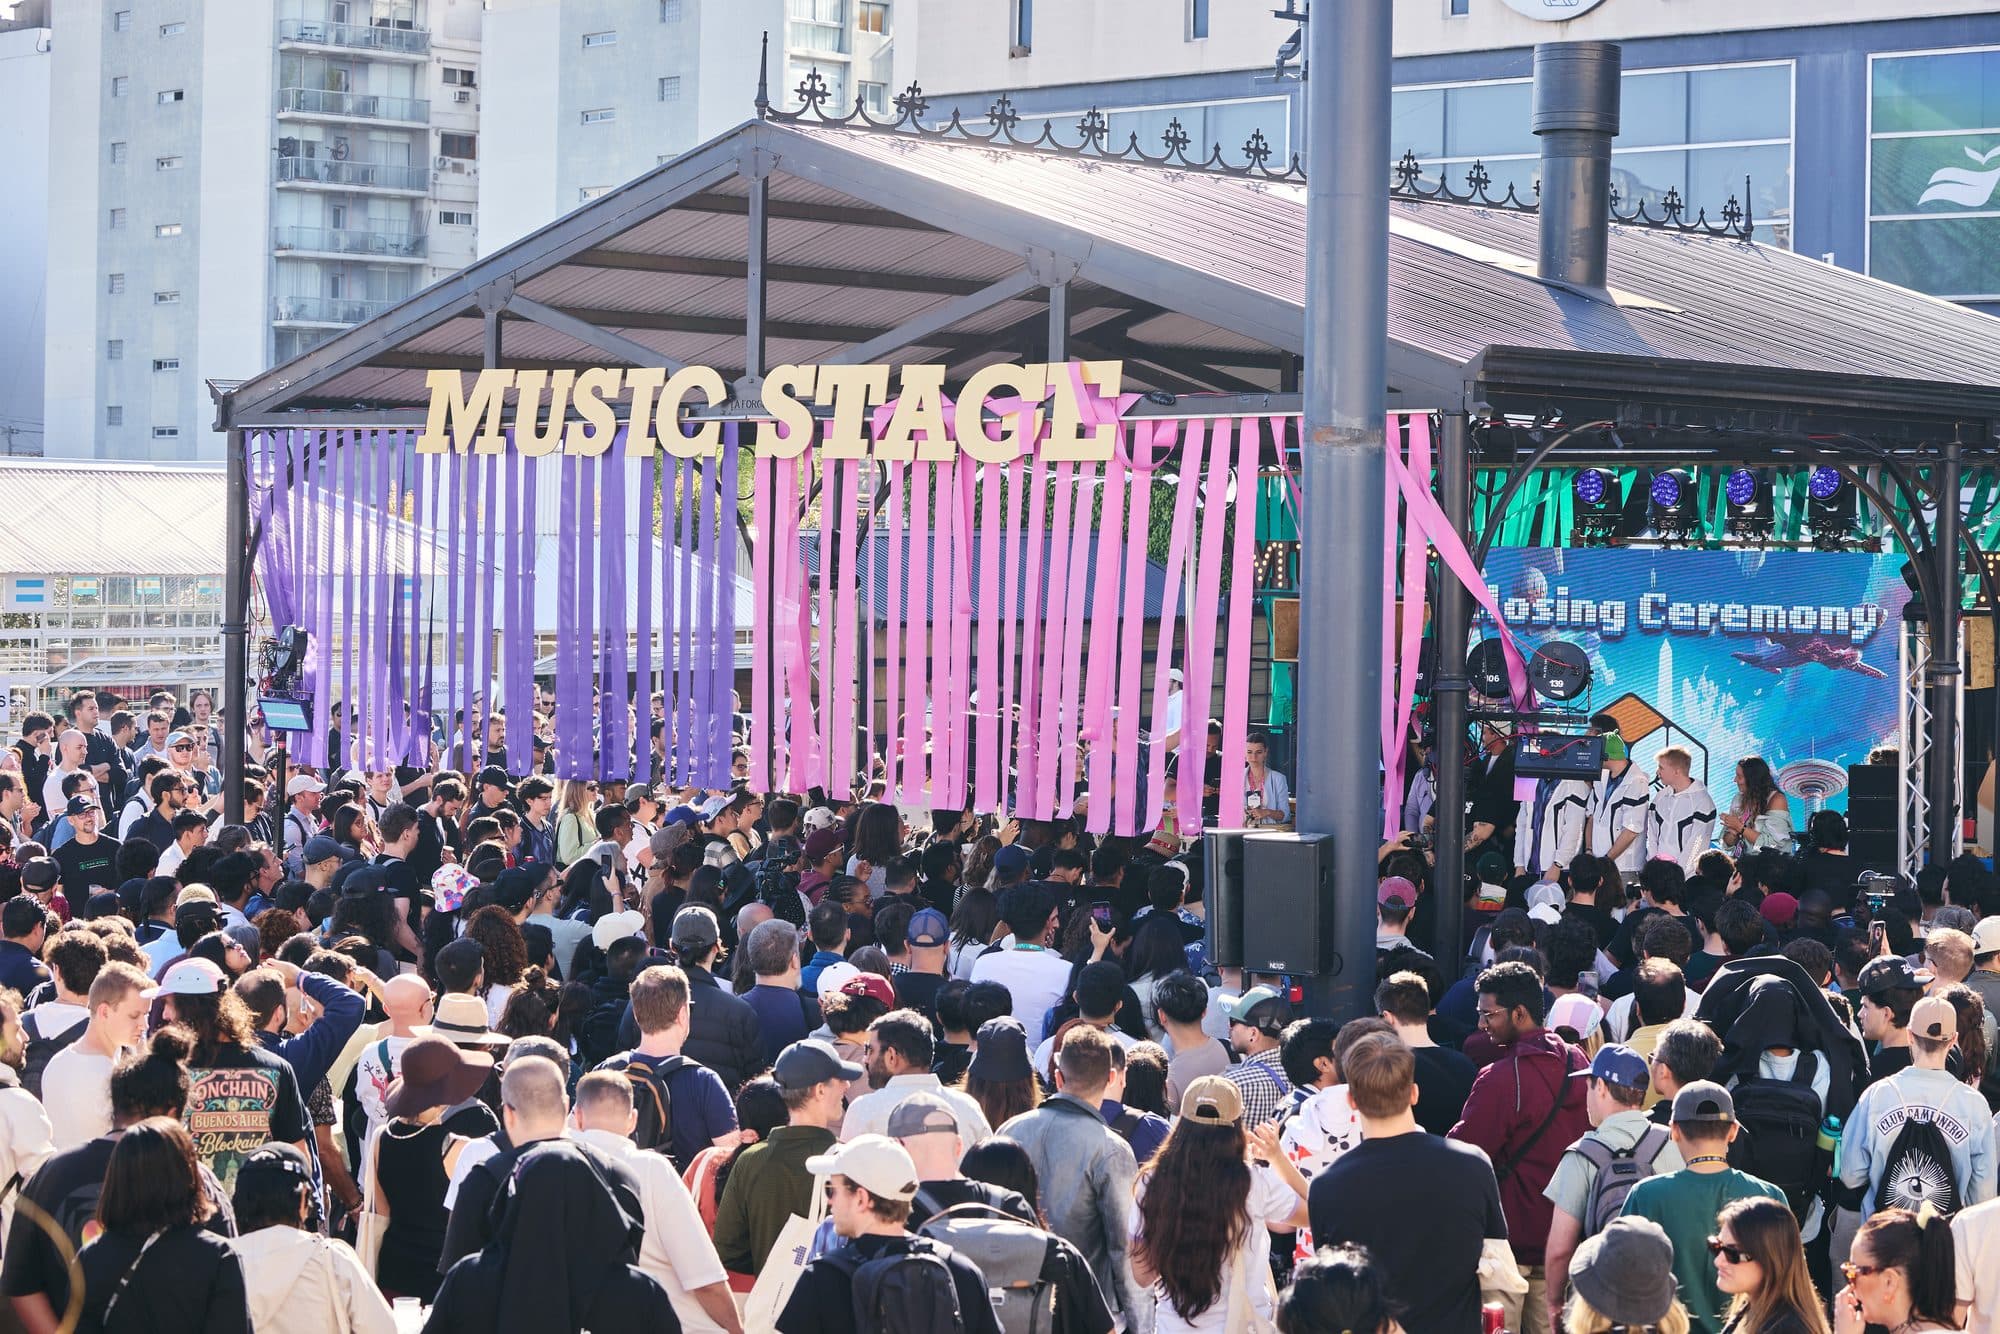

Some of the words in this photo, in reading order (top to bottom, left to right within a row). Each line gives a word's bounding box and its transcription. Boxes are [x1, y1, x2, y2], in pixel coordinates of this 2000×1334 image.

[415, 365, 728, 458] MUSIC
[755, 360, 1123, 463] STAGE
[1473, 584, 1626, 635] losing
[1639, 592, 1877, 643] Ceremony
[195, 1080, 269, 1102] ONCHAIN
[195, 1113, 238, 1128] BUENOS
[1880, 1110, 1905, 1131] CLUB
[1907, 1108, 1964, 1139] CAMINERO
[198, 1132, 267, 1155] Blockaid
